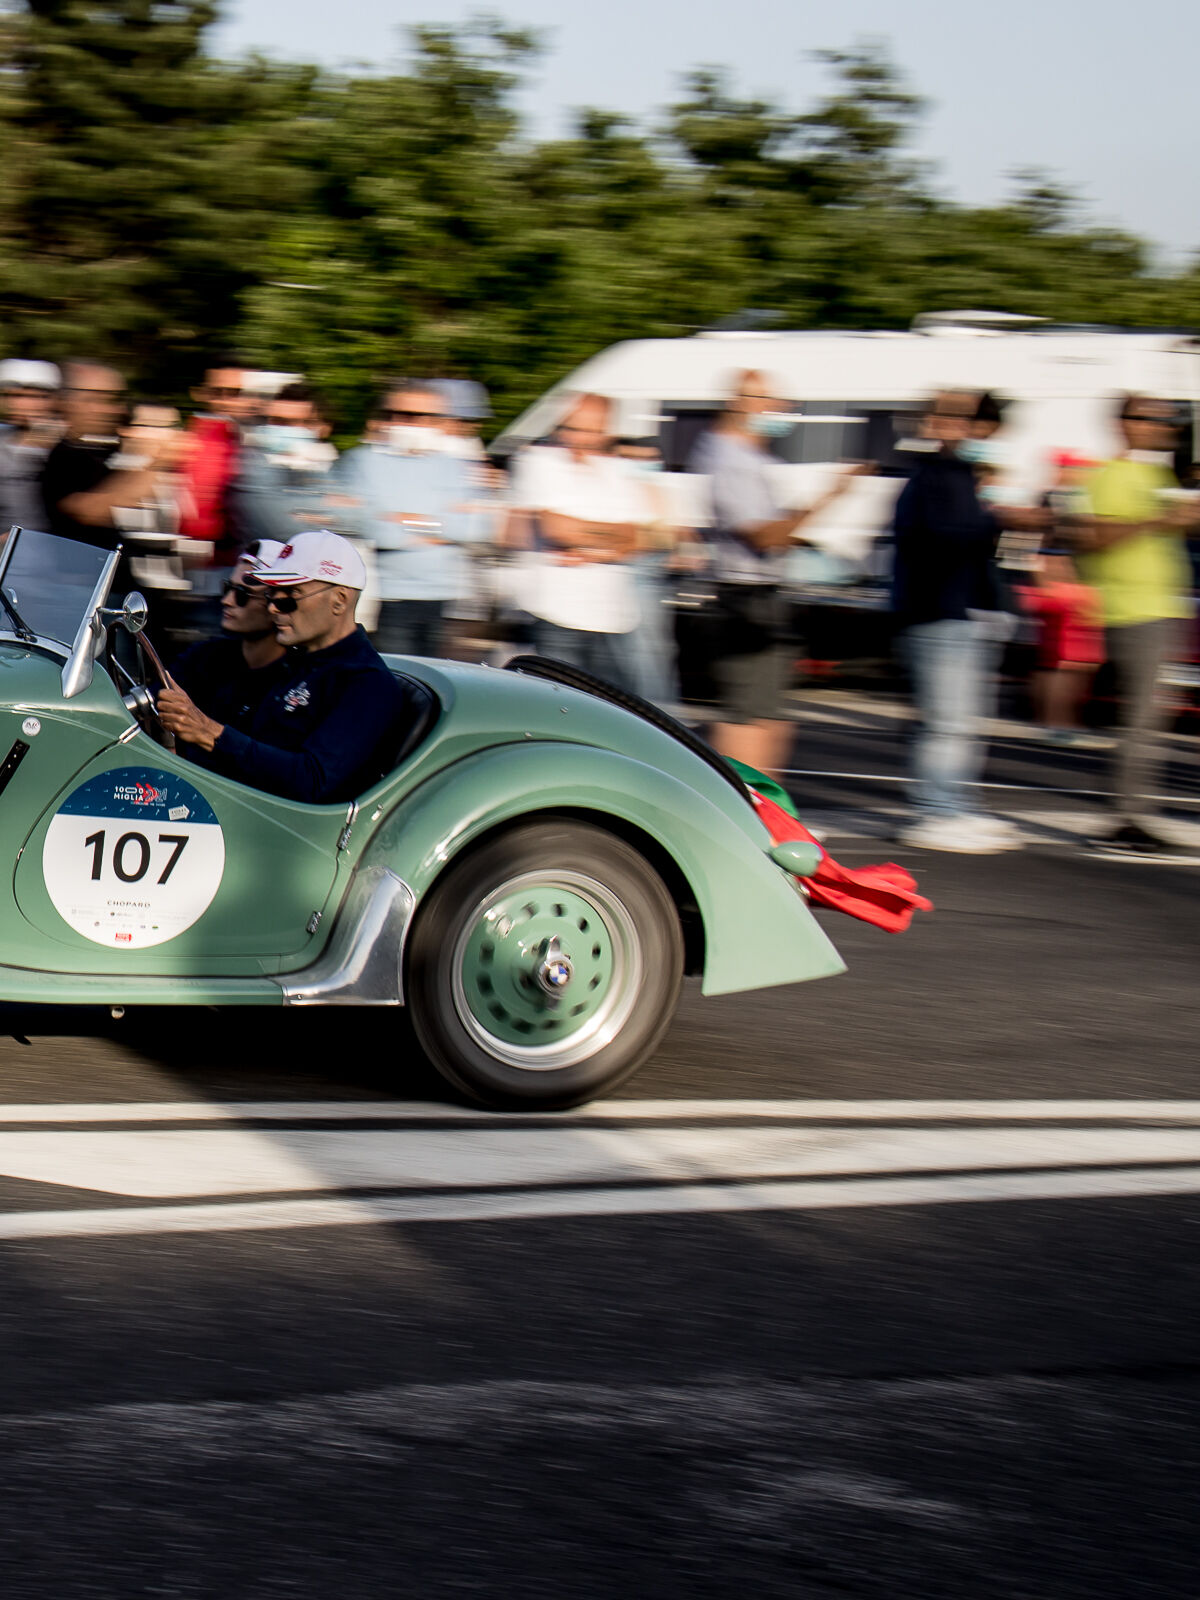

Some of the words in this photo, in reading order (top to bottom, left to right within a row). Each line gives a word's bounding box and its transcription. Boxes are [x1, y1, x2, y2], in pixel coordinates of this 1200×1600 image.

[113, 792, 144, 801] MIGLIA
[84, 829, 189, 885] 107
[107, 900, 151, 908] CHOPARD
